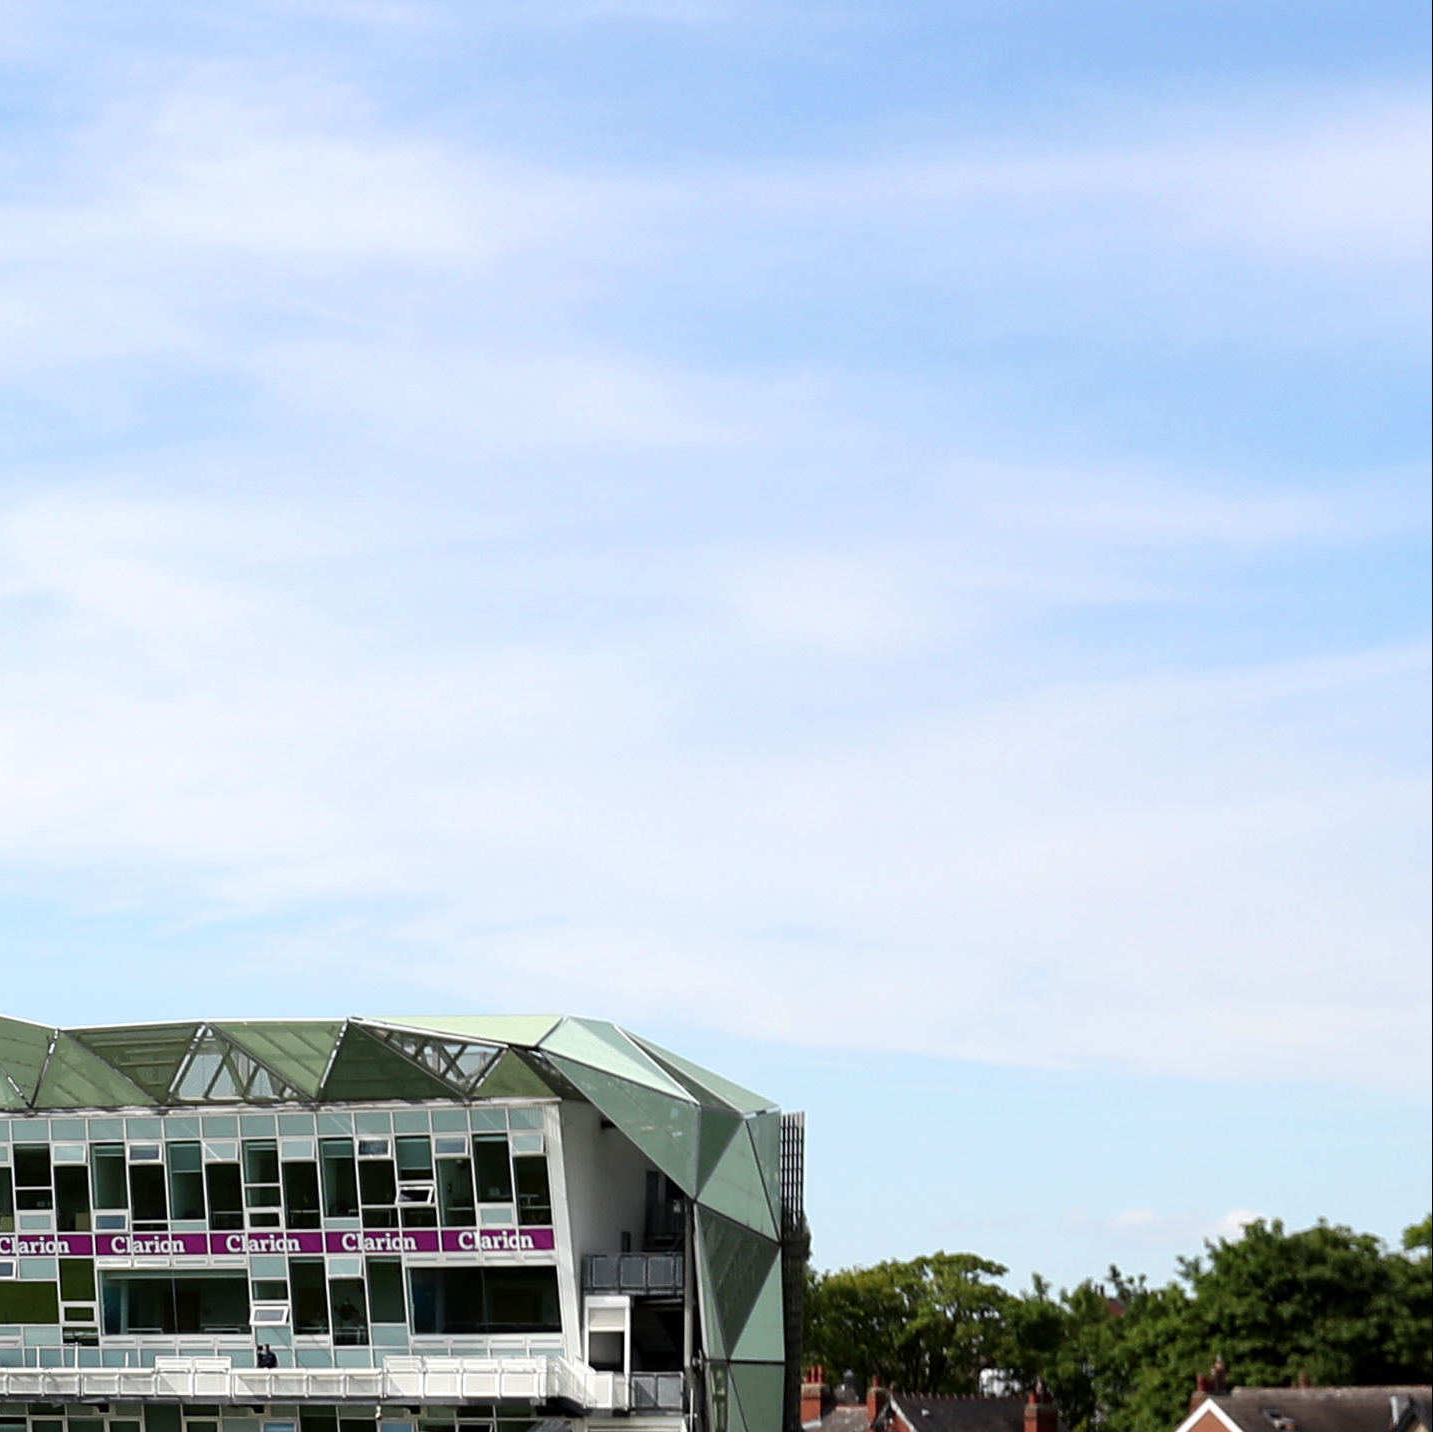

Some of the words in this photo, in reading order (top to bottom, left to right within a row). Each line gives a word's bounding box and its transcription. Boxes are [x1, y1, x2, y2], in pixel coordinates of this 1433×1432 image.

[111, 1236, 186, 1254] Clarion
[226, 1234, 301, 1252] Clarion
[342, 1233, 417, 1251] Clarion
[458, 1231, 534, 1250] Clarion
